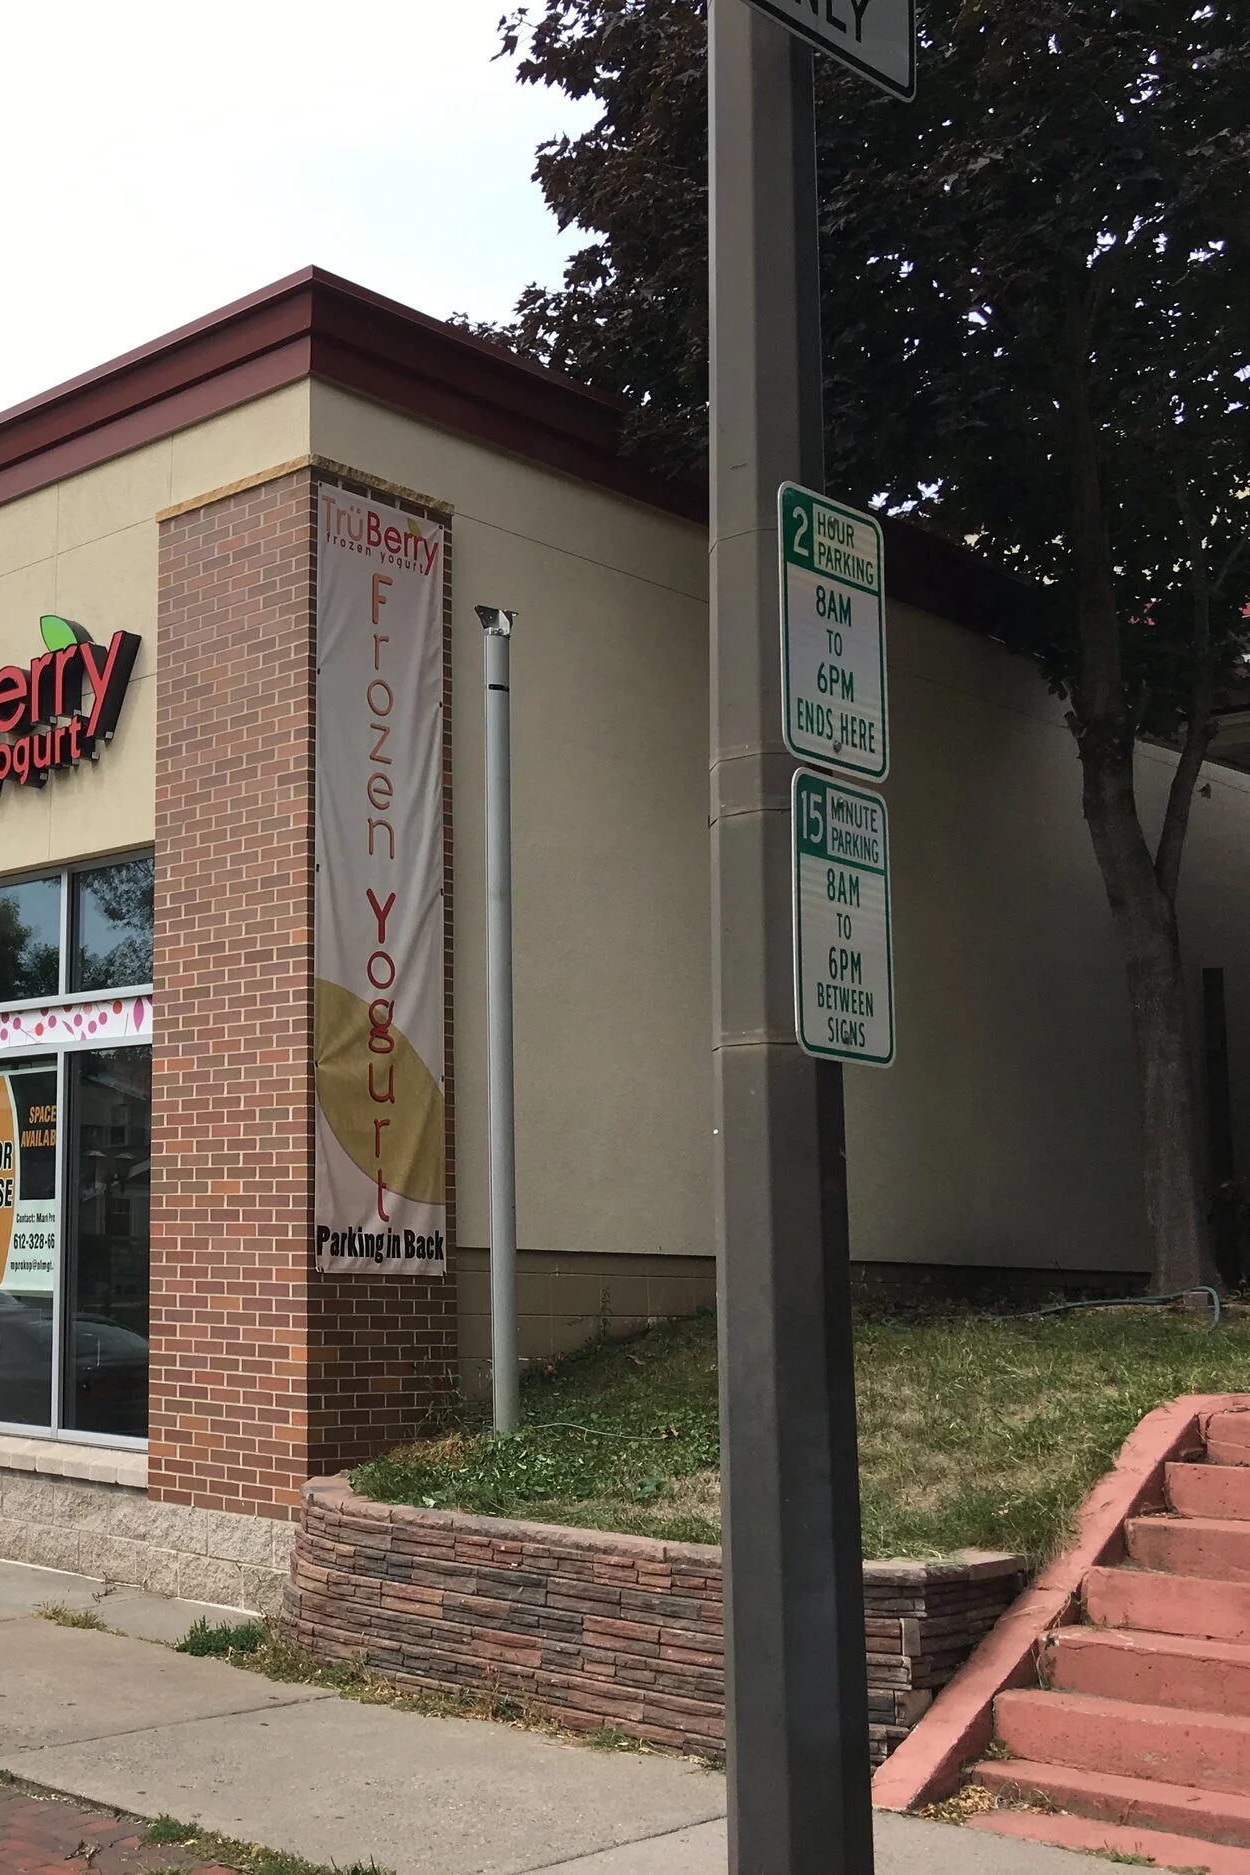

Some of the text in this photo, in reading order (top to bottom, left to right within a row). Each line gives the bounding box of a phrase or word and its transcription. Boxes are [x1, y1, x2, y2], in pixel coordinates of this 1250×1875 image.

[322, 495, 438, 576] TrüBerry
[792, 506, 809, 557] 2
[817, 511, 855, 549] HOUR
[327, 532, 424, 574] frozen yogurt
[818, 544, 874, 586] PARKING
[815, 585, 852, 627] 8AM
[826, 629, 843, 657] TO
[817, 662, 854, 703] 6PM
[367, 572, 395, 860] Frozen
[797, 697, 876, 754] ENDS HERE
[801, 790, 824, 844] 15
[831, 796, 878, 834] MINUTE
[831, 829, 879, 865] PARKING
[826, 867, 861, 908] 8AM
[836, 912, 852, 941] TO
[828, 945, 863, 986] 6PM
[817, 981, 874, 1018] BETWEEN
[827, 1016, 866, 1049] SIGNS
[367, 888, 396, 1222] Yogurt
[29, 1104, 57, 1124] SPACE
[317, 1225, 445, 1264] Parking in Back
